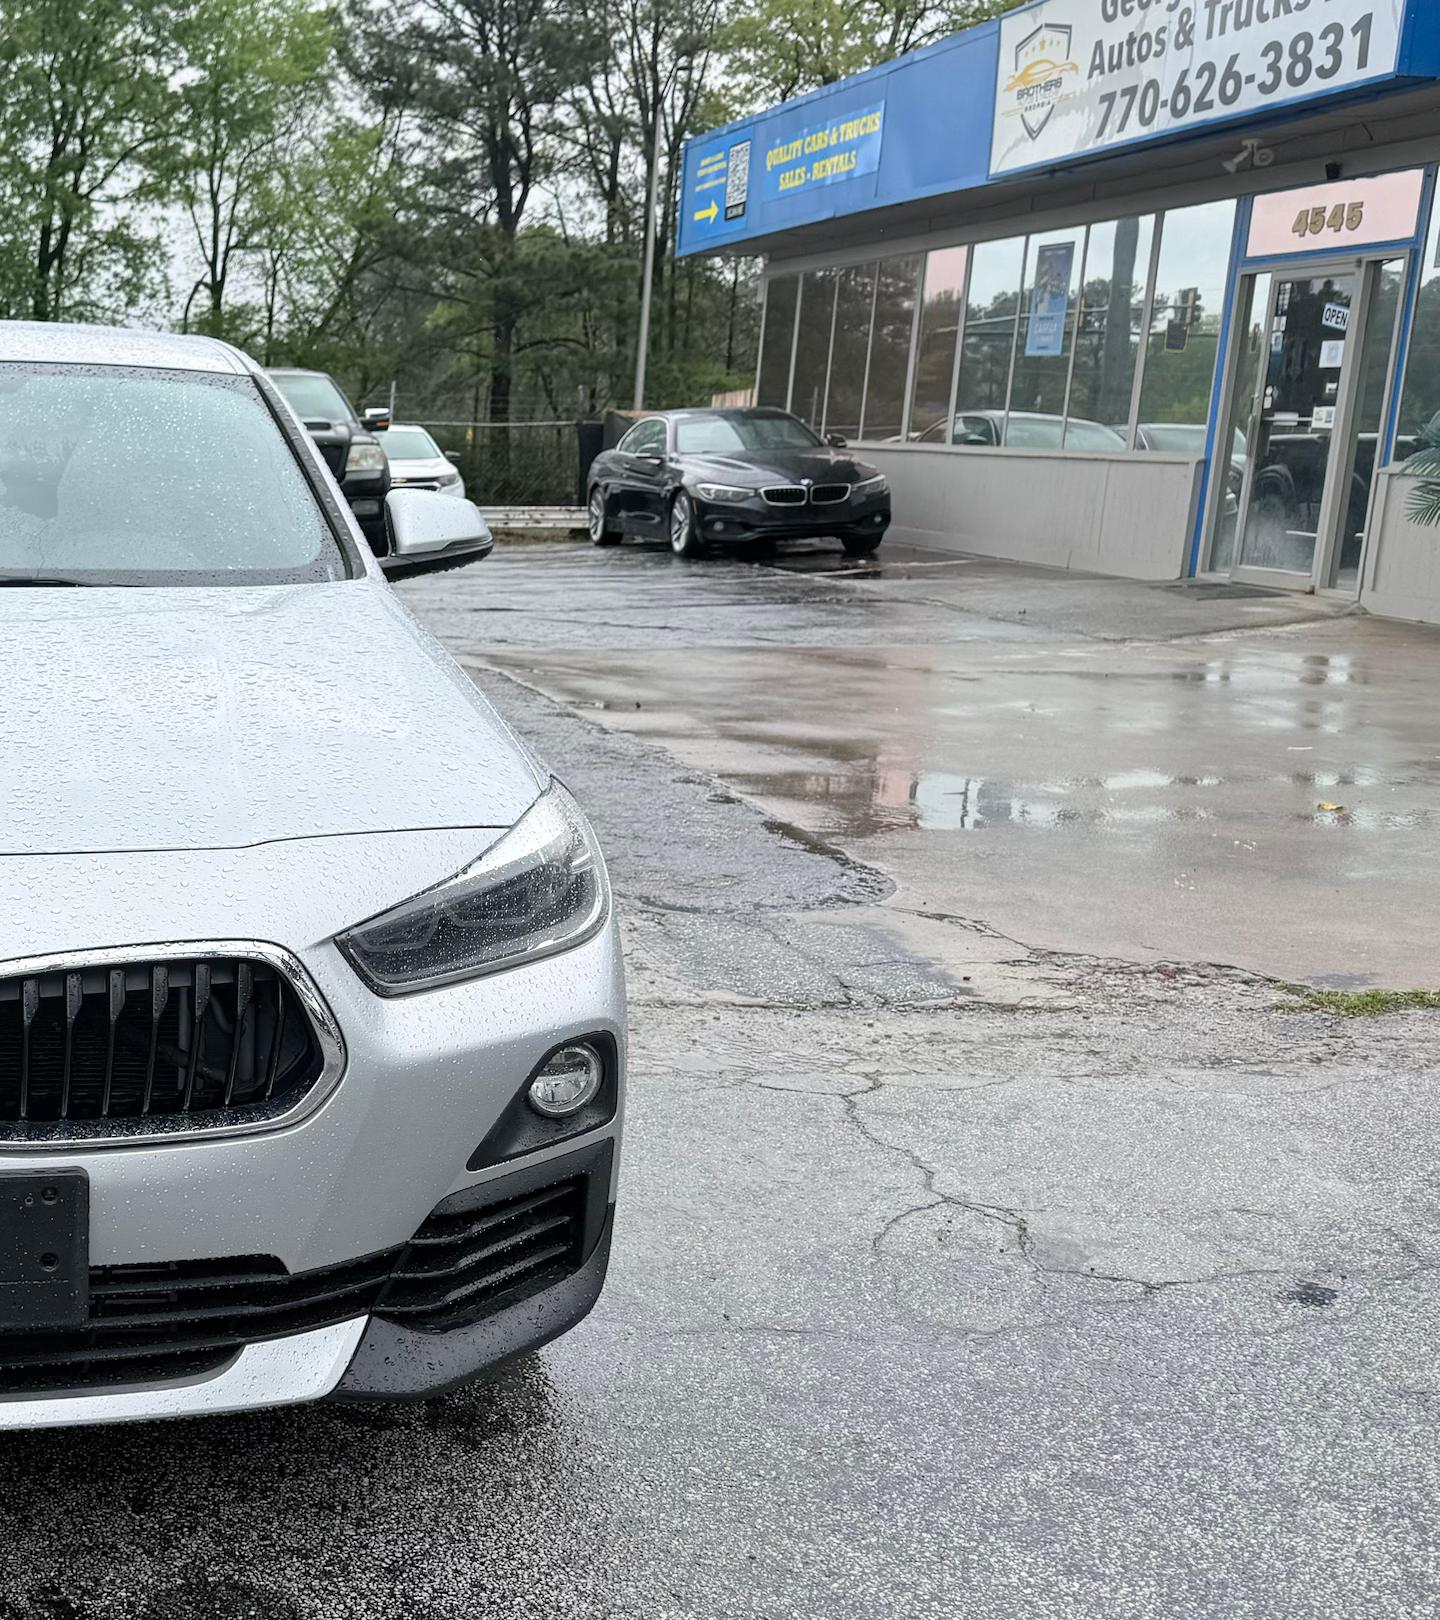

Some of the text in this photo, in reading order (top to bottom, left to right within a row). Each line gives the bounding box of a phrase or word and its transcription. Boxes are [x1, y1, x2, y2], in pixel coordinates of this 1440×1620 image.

[1087, 26, 1167, 80] Autos
[1174, 6, 1195, 51] &
[1095, 12, 1374, 139] 770-626-3831
[766, 111, 881, 172] QUALITY CARS & TRUCKS
[779, 166, 806, 191] SALES
[812, 150, 857, 181] RENTALS
[1291, 201, 1364, 238] 4545
[1324, 307, 1348, 328] OPEN
